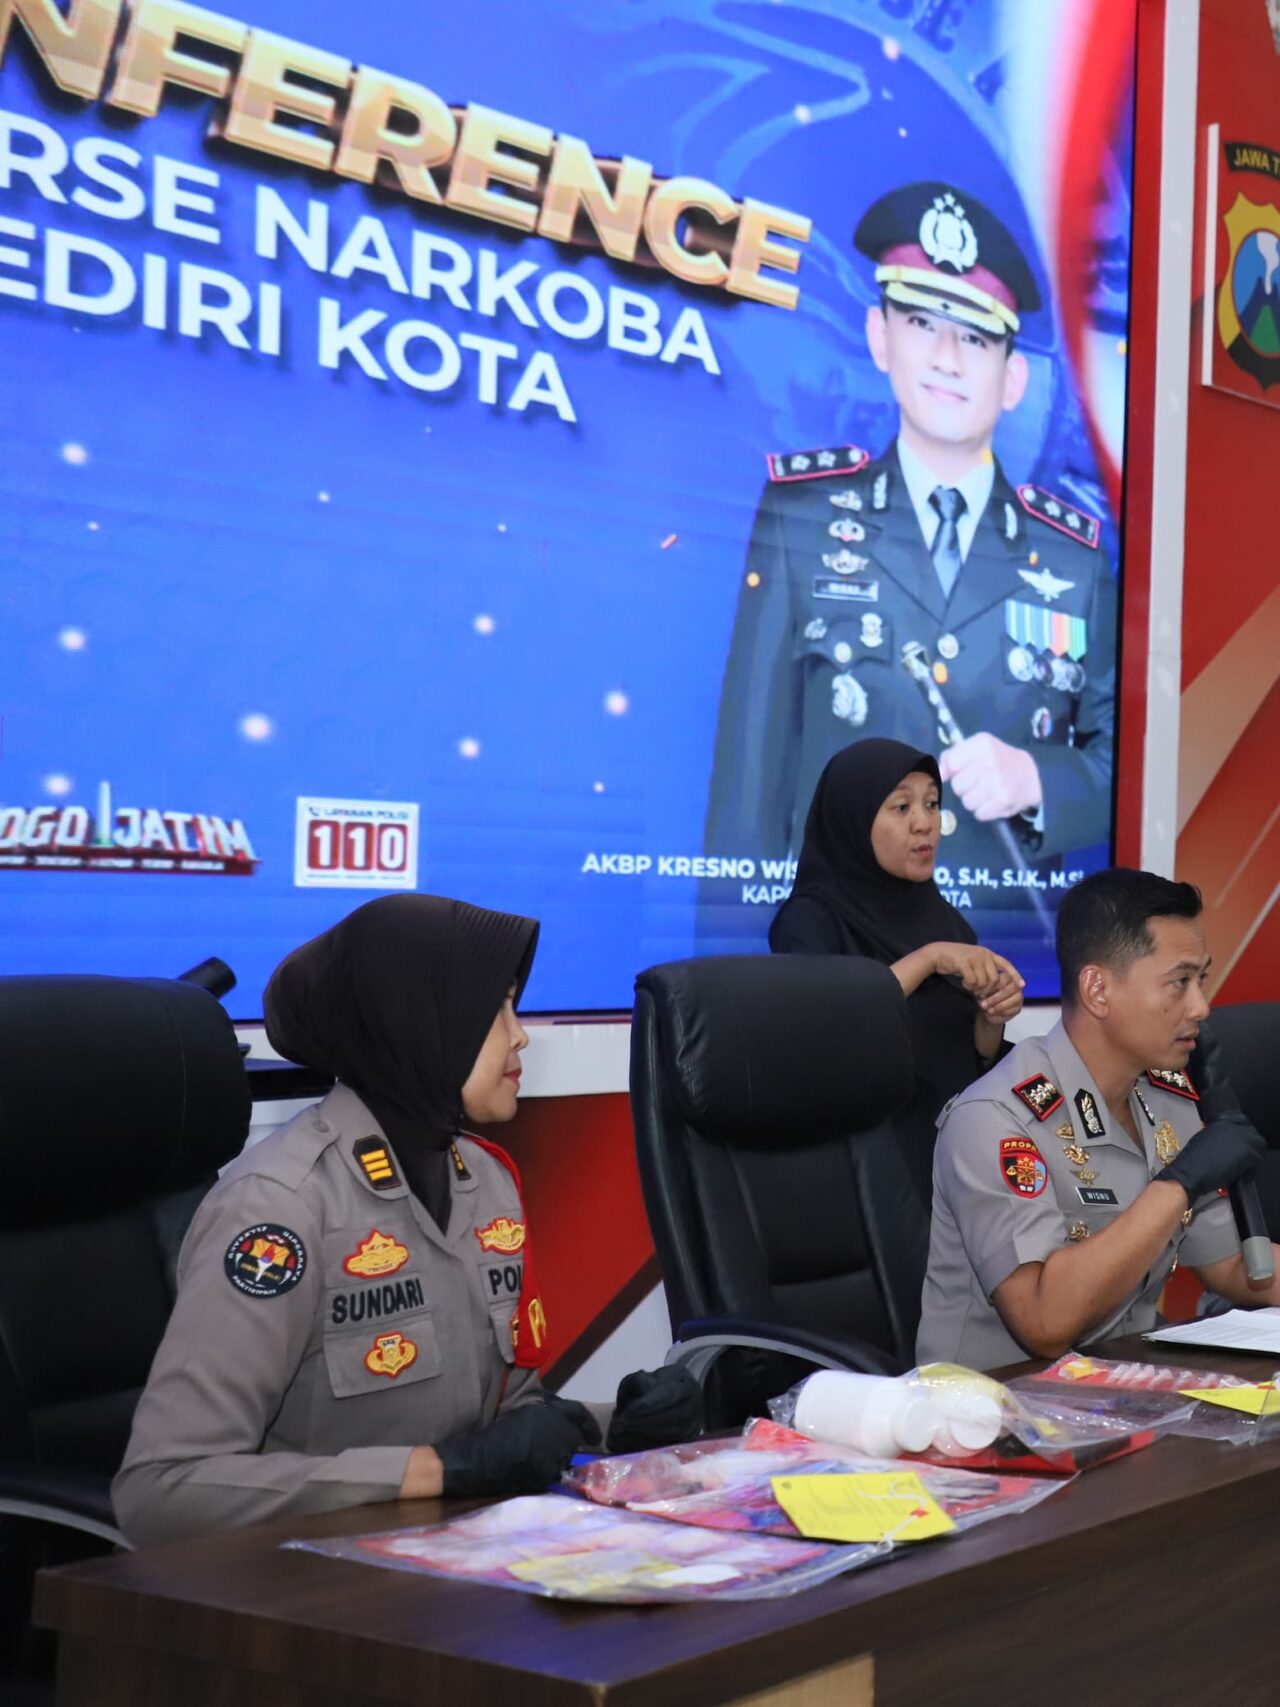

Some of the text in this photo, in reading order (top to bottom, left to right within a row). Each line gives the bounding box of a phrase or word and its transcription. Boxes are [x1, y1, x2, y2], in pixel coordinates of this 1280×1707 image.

[1234, 147, 1271, 172] JAWA
[0, 108, 722, 376] RSE NARKOBA
[317, 297, 578, 423] KOTA
[312, 825, 406, 869] 110
[581, 853, 652, 875] AKBP
[656, 856, 756, 879] KRESNO
[958, 867, 999, 889] S.H.,
[331, 1277, 425, 1325] SUNDARI
